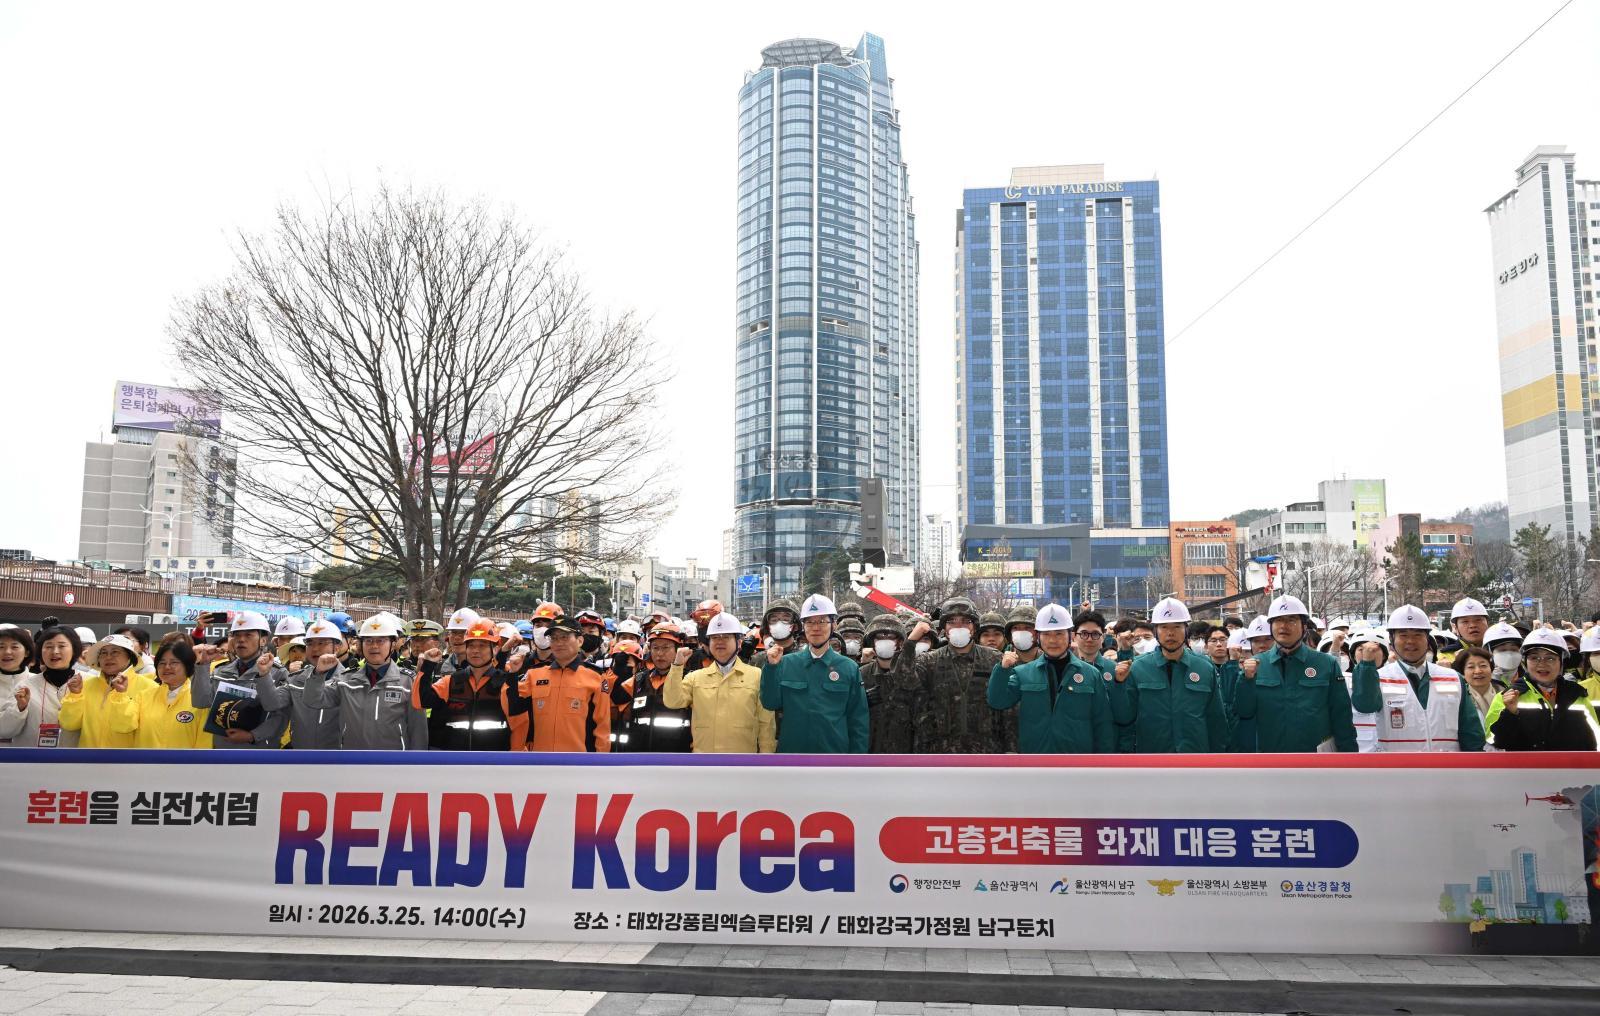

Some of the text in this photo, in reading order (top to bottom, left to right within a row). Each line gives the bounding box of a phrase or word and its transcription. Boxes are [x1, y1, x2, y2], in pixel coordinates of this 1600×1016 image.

[1027, 182, 1124, 196] CITY PARADISE
[121, 385, 157, 400] 행복한
[185, 626, 229, 638] TLET
[27, 790, 259, 826] 훈련을 실전처럼
[275, 791, 855, 893] READY Korea
[925, 825, 1316, 859] 고층건축물 화재 대응 훈련
[914, 879, 961, 890] 행정안전부
[990, 880, 1038, 892] 울산광역시
[1075, 880, 1135, 890] 울산광역시 남구
[1187, 879, 1268, 890] 울산광역시 소방본부
[1294, 880, 1351, 893] 울산경찰청
[269, 904, 302, 924] 일시
[318, 905, 426, 926] 2026.3.25.
[433, 906, 526, 929] 14:00(수)
[573, 911, 609, 931] 장소
[627, 911, 813, 934] 태화강풍림엑슬루타워
[837, 915, 971, 937] 태화강국가정원
[978, 917, 1055, 938] 남구둔치
